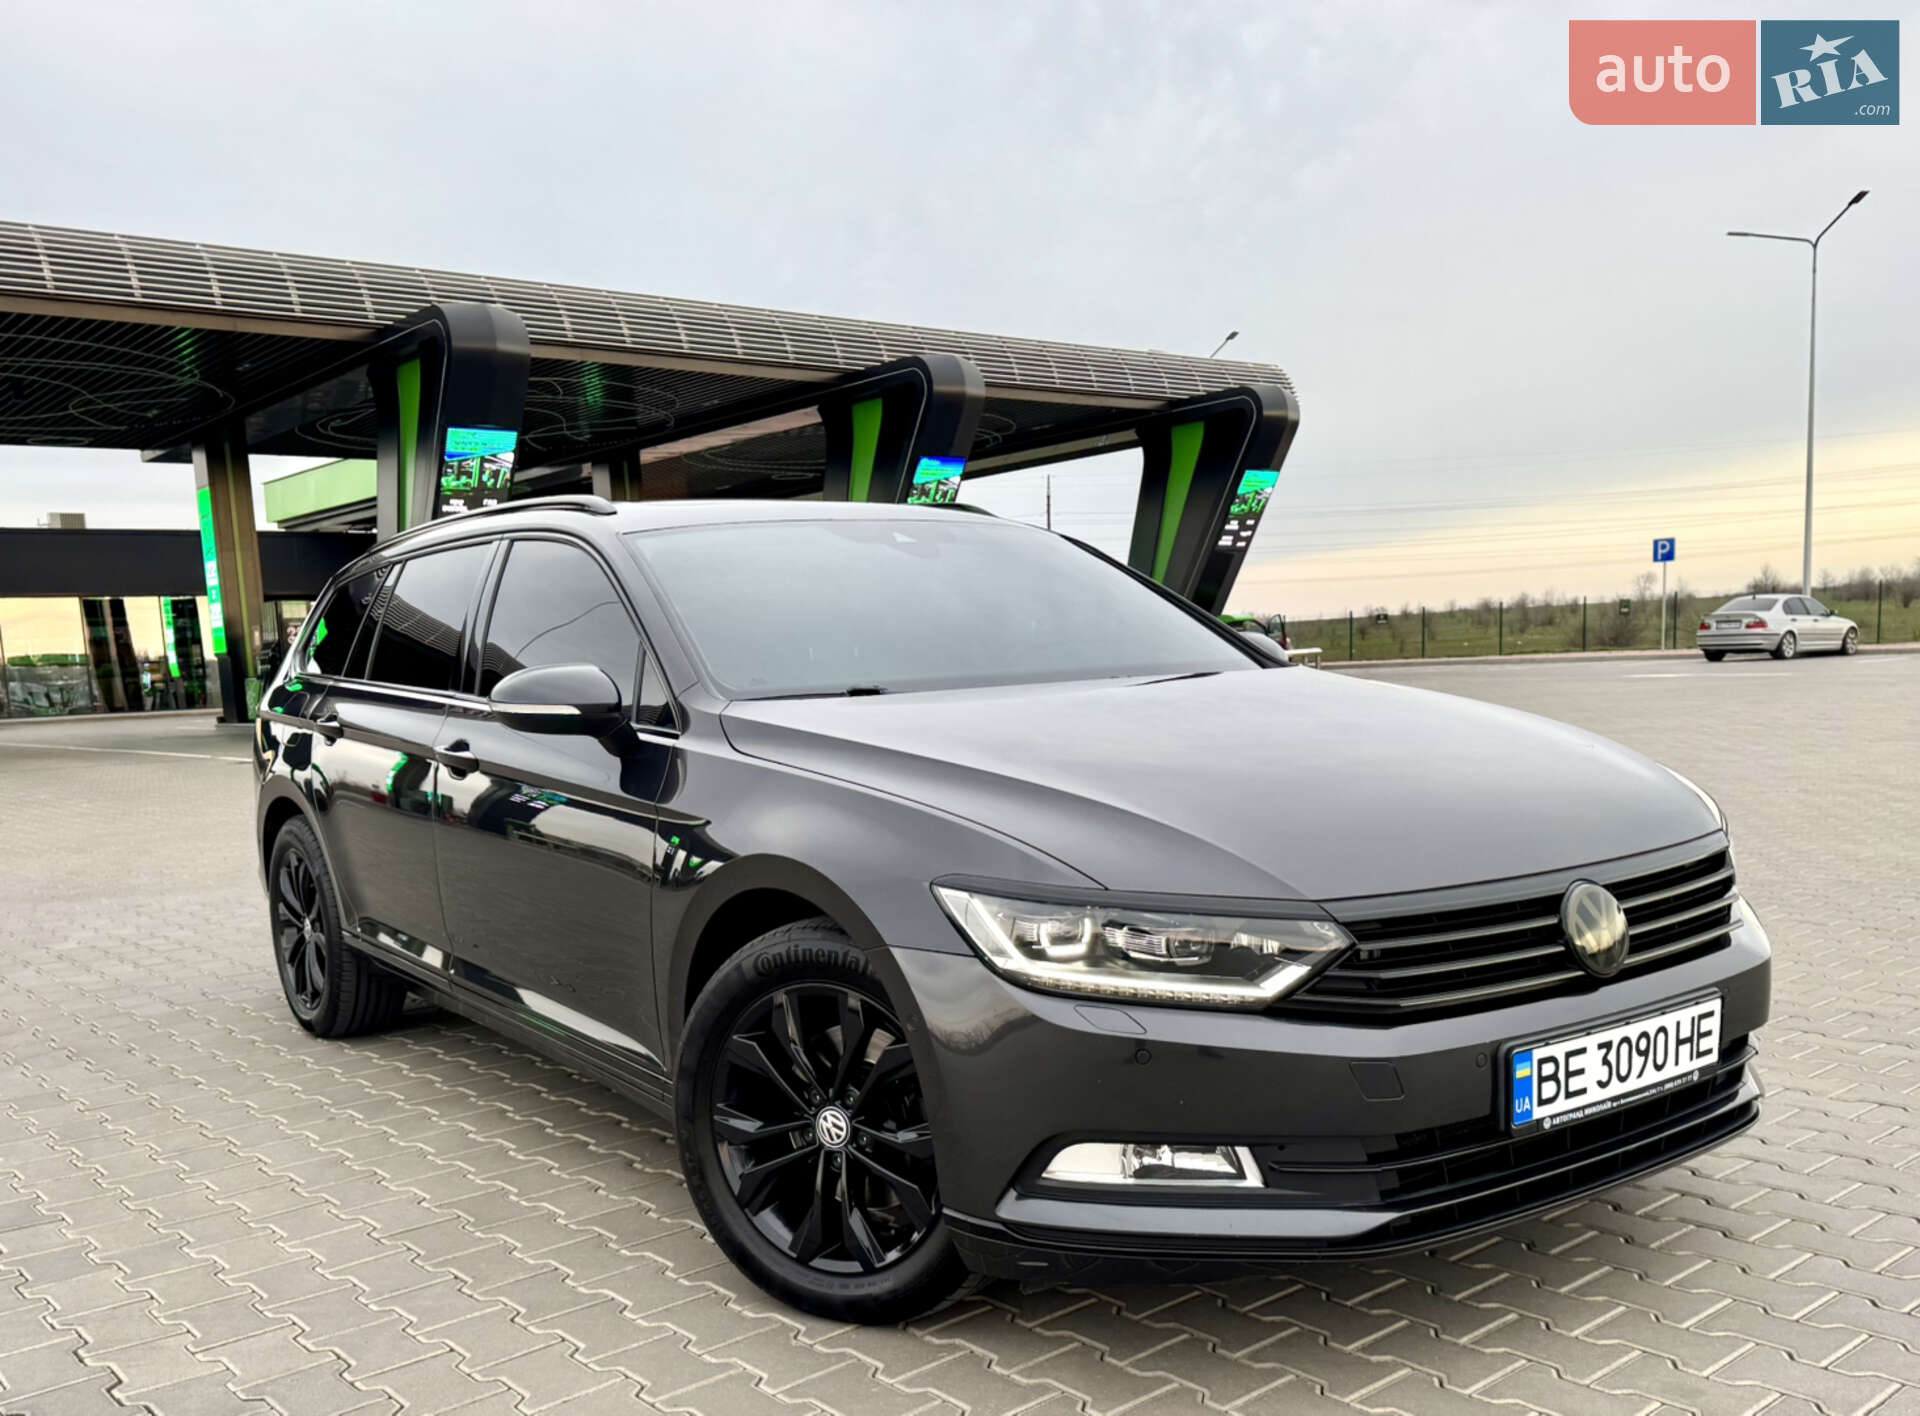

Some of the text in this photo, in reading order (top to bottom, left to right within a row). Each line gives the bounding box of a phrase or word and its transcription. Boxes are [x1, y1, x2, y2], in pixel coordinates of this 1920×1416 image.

[1657, 540, 1670, 560] P
[752, 944, 870, 977] Continental
[1537, 1010, 1715, 1108] BE 3090 HE
[1515, 1096, 1531, 1113] UA
